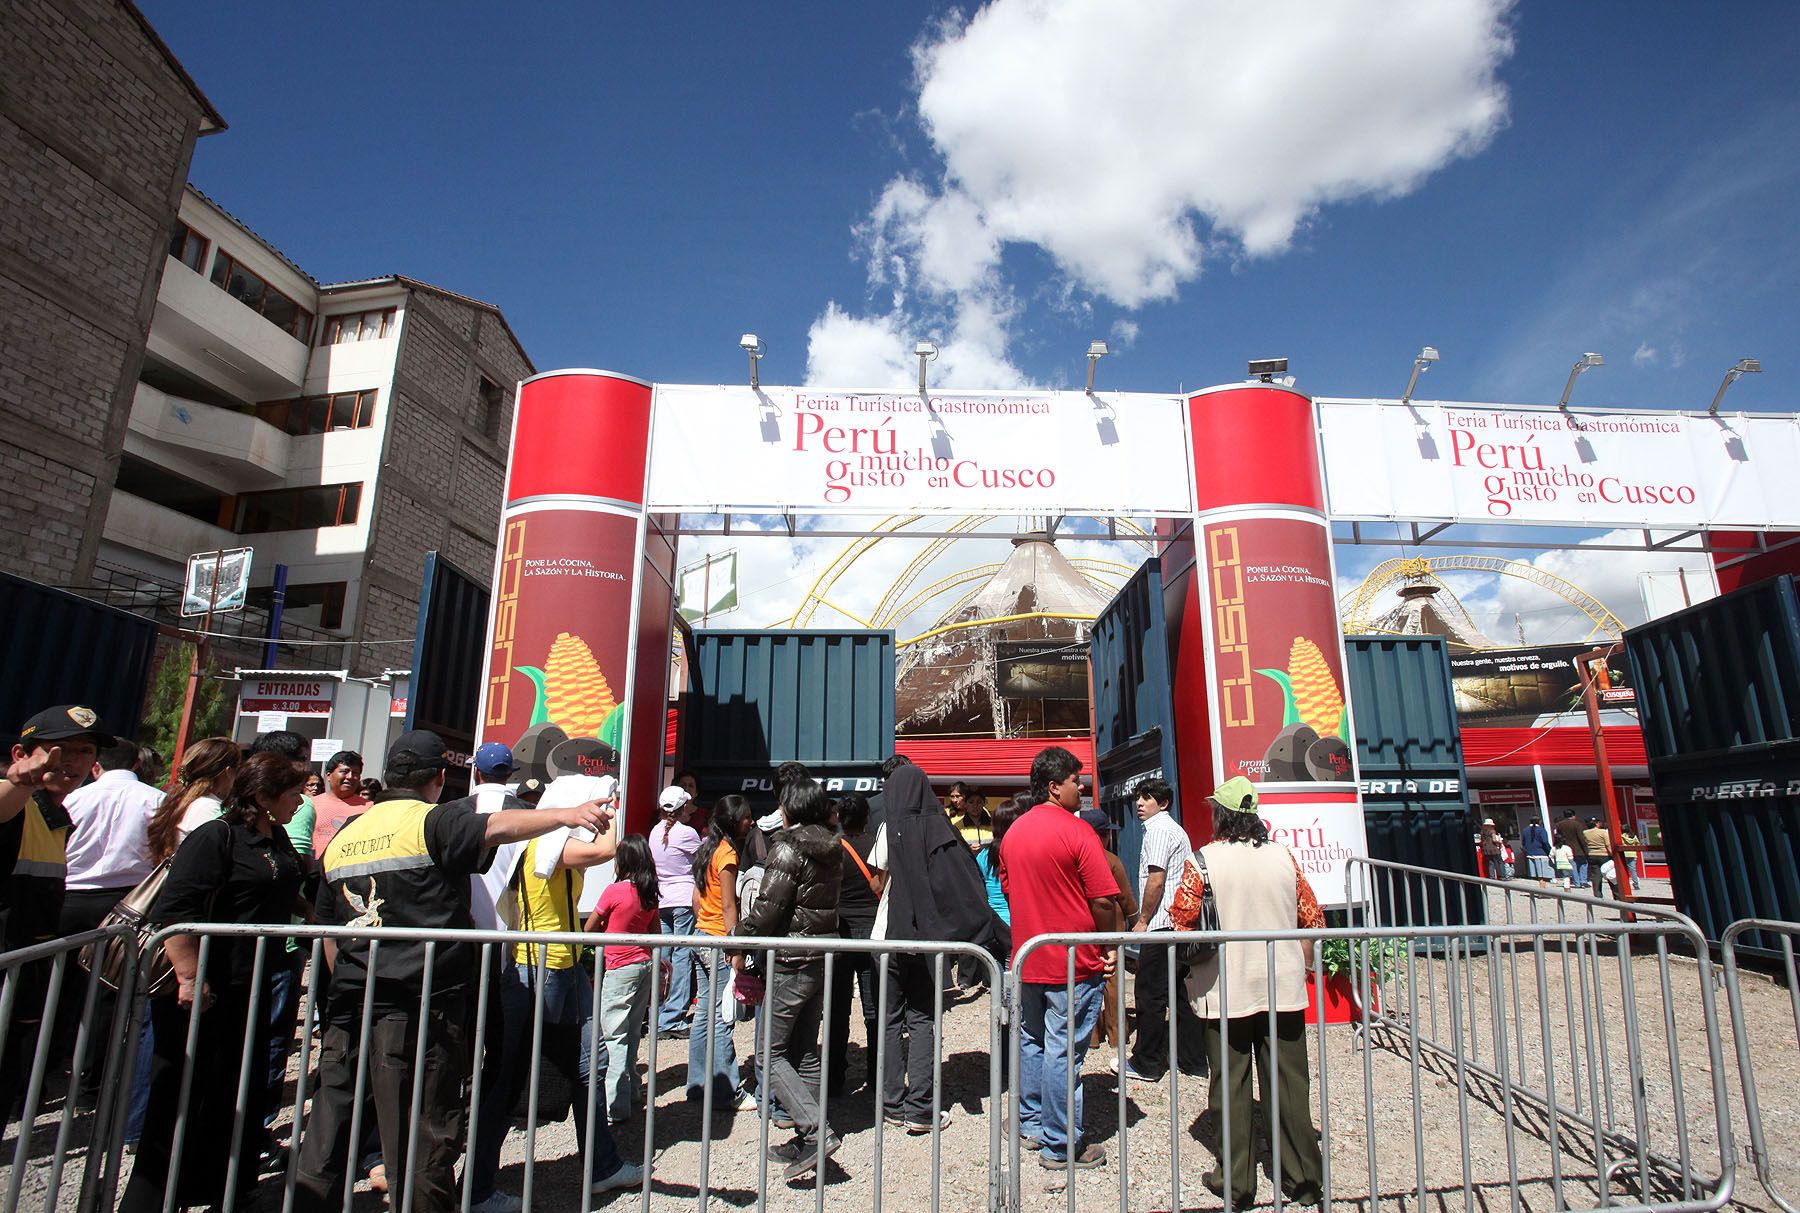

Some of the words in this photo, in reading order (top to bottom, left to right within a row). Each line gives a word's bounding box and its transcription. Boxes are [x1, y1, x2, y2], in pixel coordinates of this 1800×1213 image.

[796, 394, 840, 411] Feria
[846, 396, 922, 412] Turística
[929, 397, 1050, 414] Gastronómica
[1445, 411, 1487, 428] Feria
[1491, 413, 1562, 430] Turística
[1566, 416, 1681, 433] Gastronómica
[860, 448, 949, 471] mucho
[824, 460, 905, 503] gusto
[928, 476, 949, 488] en
[953, 461, 1056, 488] Cusco
[1513, 464, 1594, 487] mucho
[1484, 475, 1557, 517] gusto
[1577, 491, 1597, 503] en
[1598, 477, 1696, 504] Cusco
[1499, 664, 1528, 672] motivos
[1530, 662, 1539, 670] de
[257, 682, 321, 697] ENTRADAS
[281, 701, 300, 711] 3.00
[1428, 780, 1460, 793] DE
[1691, 782, 1777, 801] PUERTA
[340, 833, 395, 858] SECURITY
[1301, 841, 1353, 861] mucho
